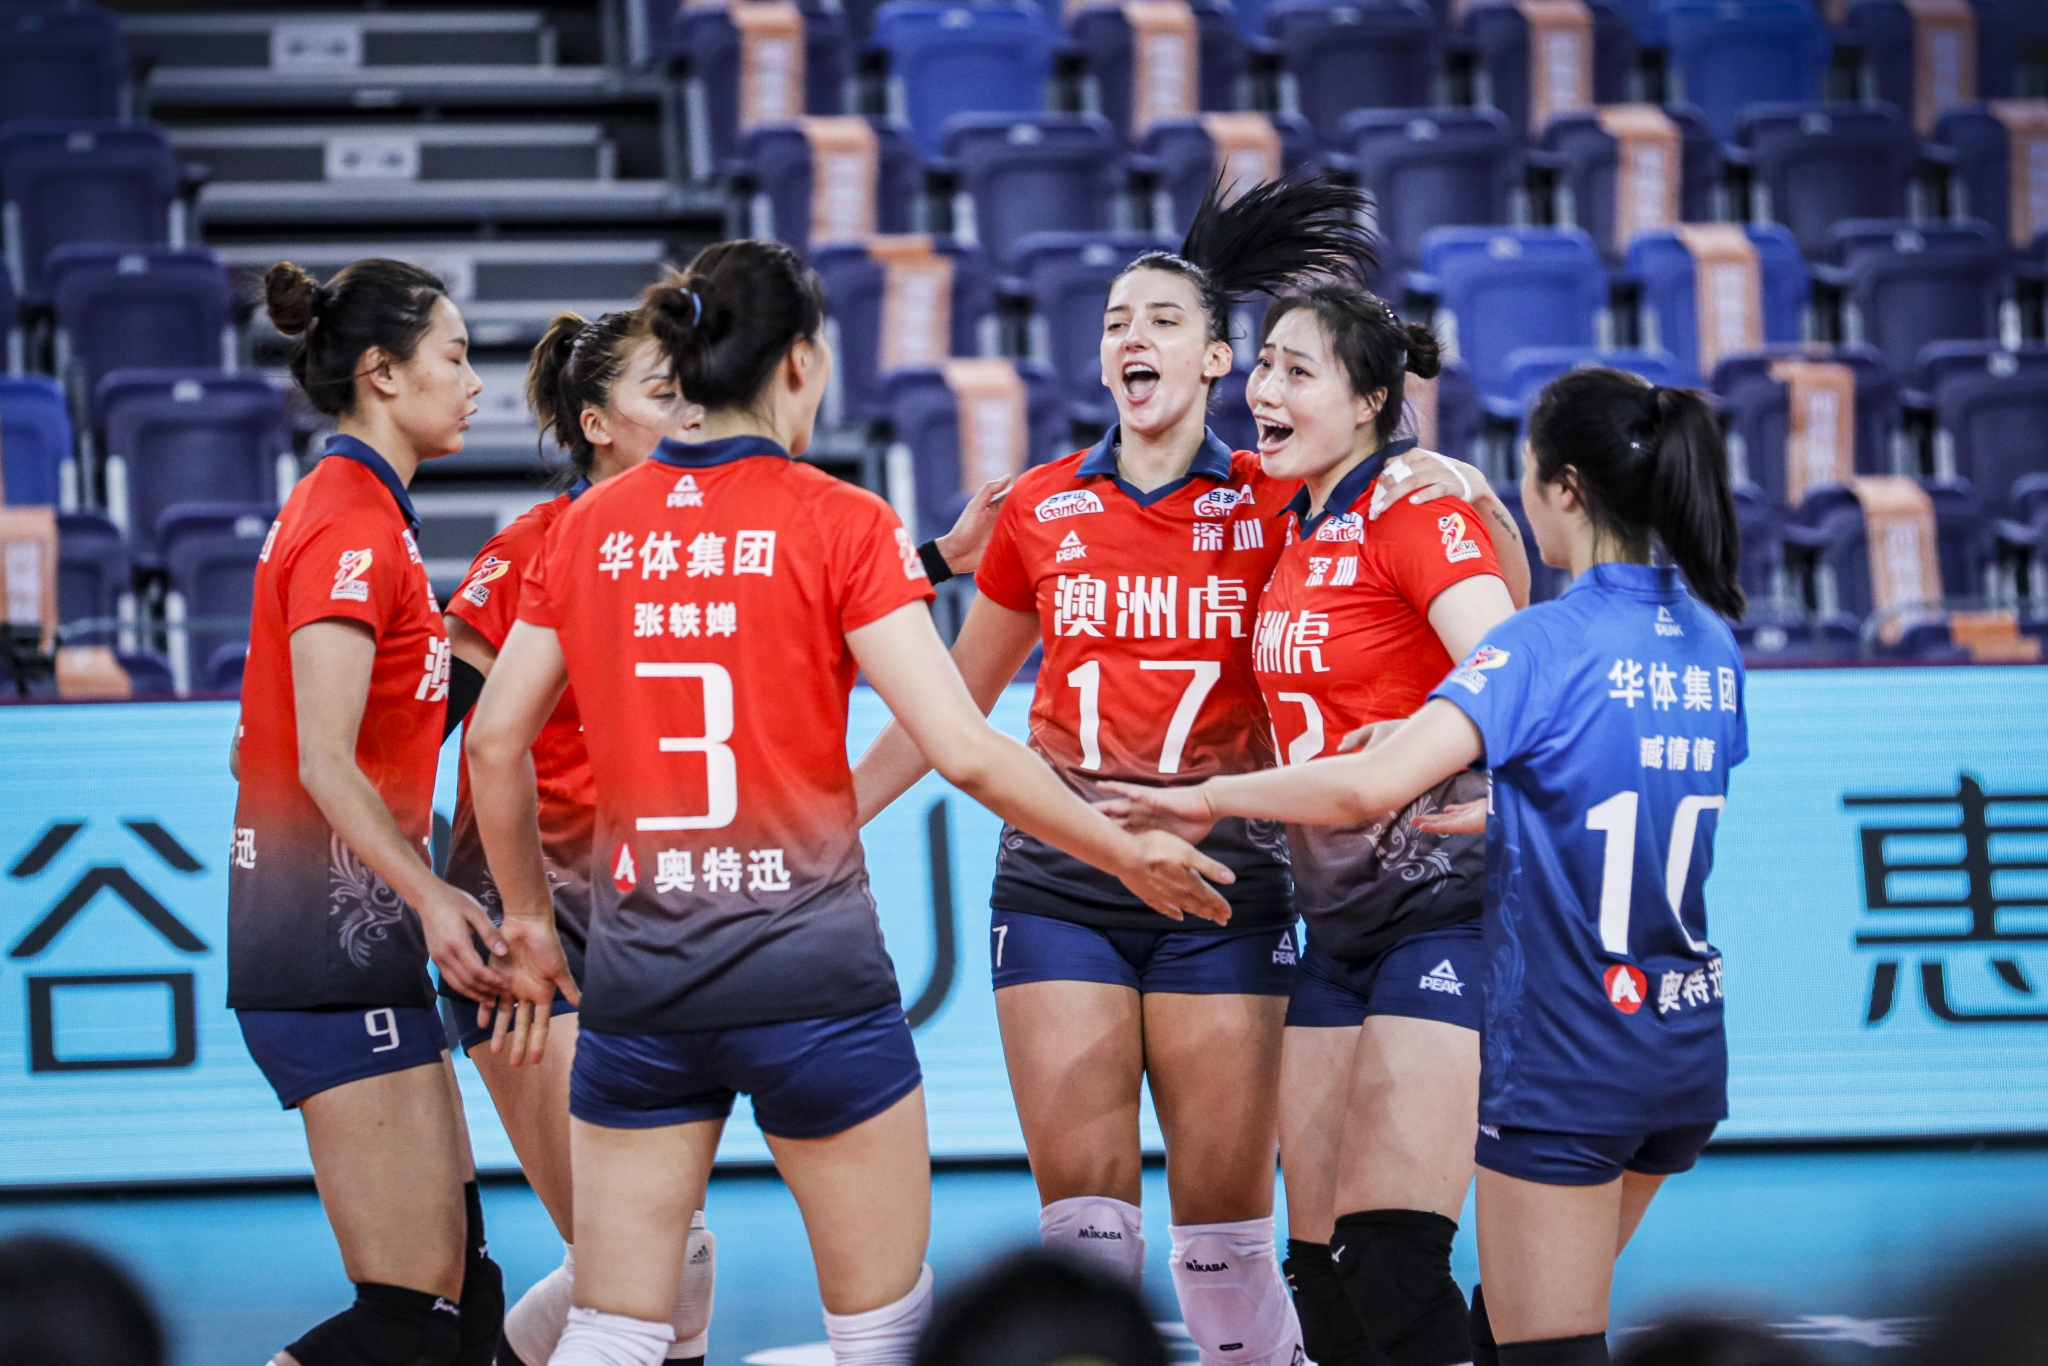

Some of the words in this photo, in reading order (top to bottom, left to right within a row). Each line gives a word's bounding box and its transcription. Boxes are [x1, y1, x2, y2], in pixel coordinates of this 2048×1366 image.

[667, 492, 704, 507] PEAK
[598, 530, 776, 580] 华体集团
[1056, 545, 1087, 563] PEAK
[1193, 518, 1264, 551] 深圳
[1305, 556, 1358, 587] 深圳
[633, 602, 737, 638] 张轶婵
[1054, 574, 1247, 639] 澳洲虎
[1252, 610, 1330, 674] 洲虎
[1655, 624, 1684, 637] PEAK
[1608, 659, 1737, 713] 华体集团
[1067, 660, 1221, 774] 17
[635, 662, 738, 831] 3
[654, 847, 791, 893] 奥特迅
[9, 822, 212, 1072] 谷
[1272, 951, 1297, 966] PEAK
[1419, 975, 1465, 996] PEAK
[364, 1007, 400, 1053] 9
